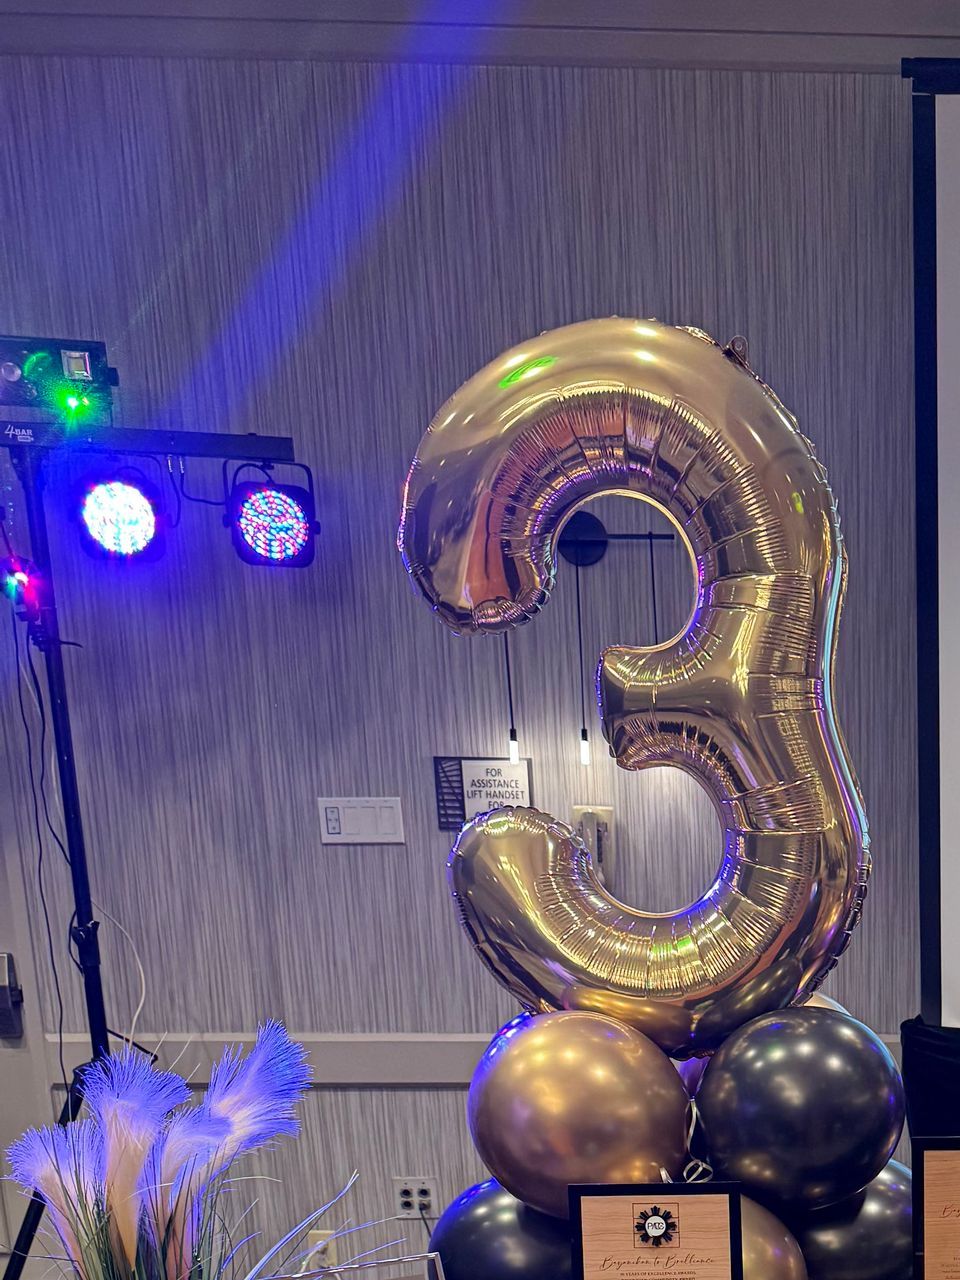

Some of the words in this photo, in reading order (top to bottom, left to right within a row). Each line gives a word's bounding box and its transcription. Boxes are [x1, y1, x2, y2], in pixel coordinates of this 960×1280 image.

[485, 768, 503, 777] FOR
[470, 779, 520, 789] ASSISTANCE
[466, 790, 482, 799] LIFT
[485, 790, 525, 800] HANDSET
